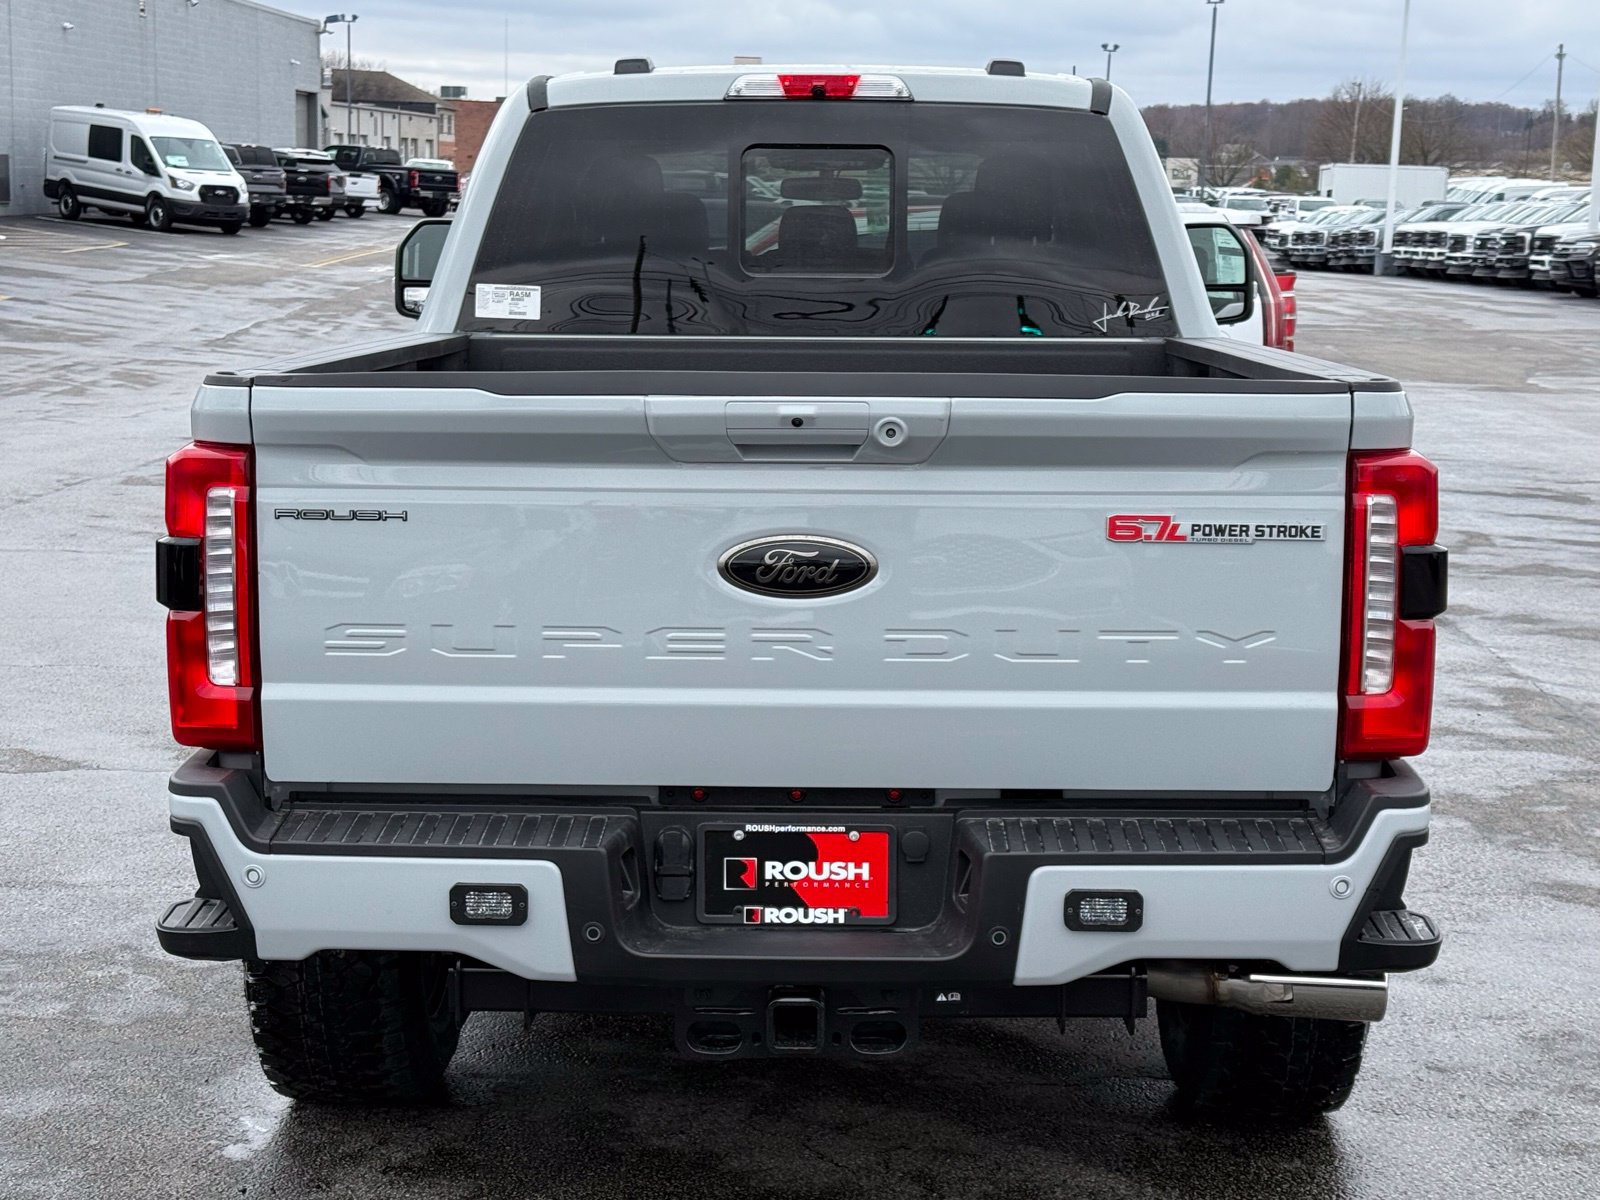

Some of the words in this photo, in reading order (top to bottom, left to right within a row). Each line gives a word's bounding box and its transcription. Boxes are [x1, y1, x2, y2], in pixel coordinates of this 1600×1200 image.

[274, 508, 408, 522] ROUSH
[1106, 514, 1187, 543] 6.7L
[1190, 523, 1250, 538] POWER
[1254, 524, 1322, 539] STROKE
[755, 549, 840, 585] Ford
[324, 622, 834, 661] SUPER
[883, 628, 1276, 664] DUTY
[745, 824, 846, 833] ROUSHperformance.com
[764, 860, 870, 881] ROUSH
[765, 881, 870, 889] PERFORMANCE
[764, 907, 846, 924] ROUSH
